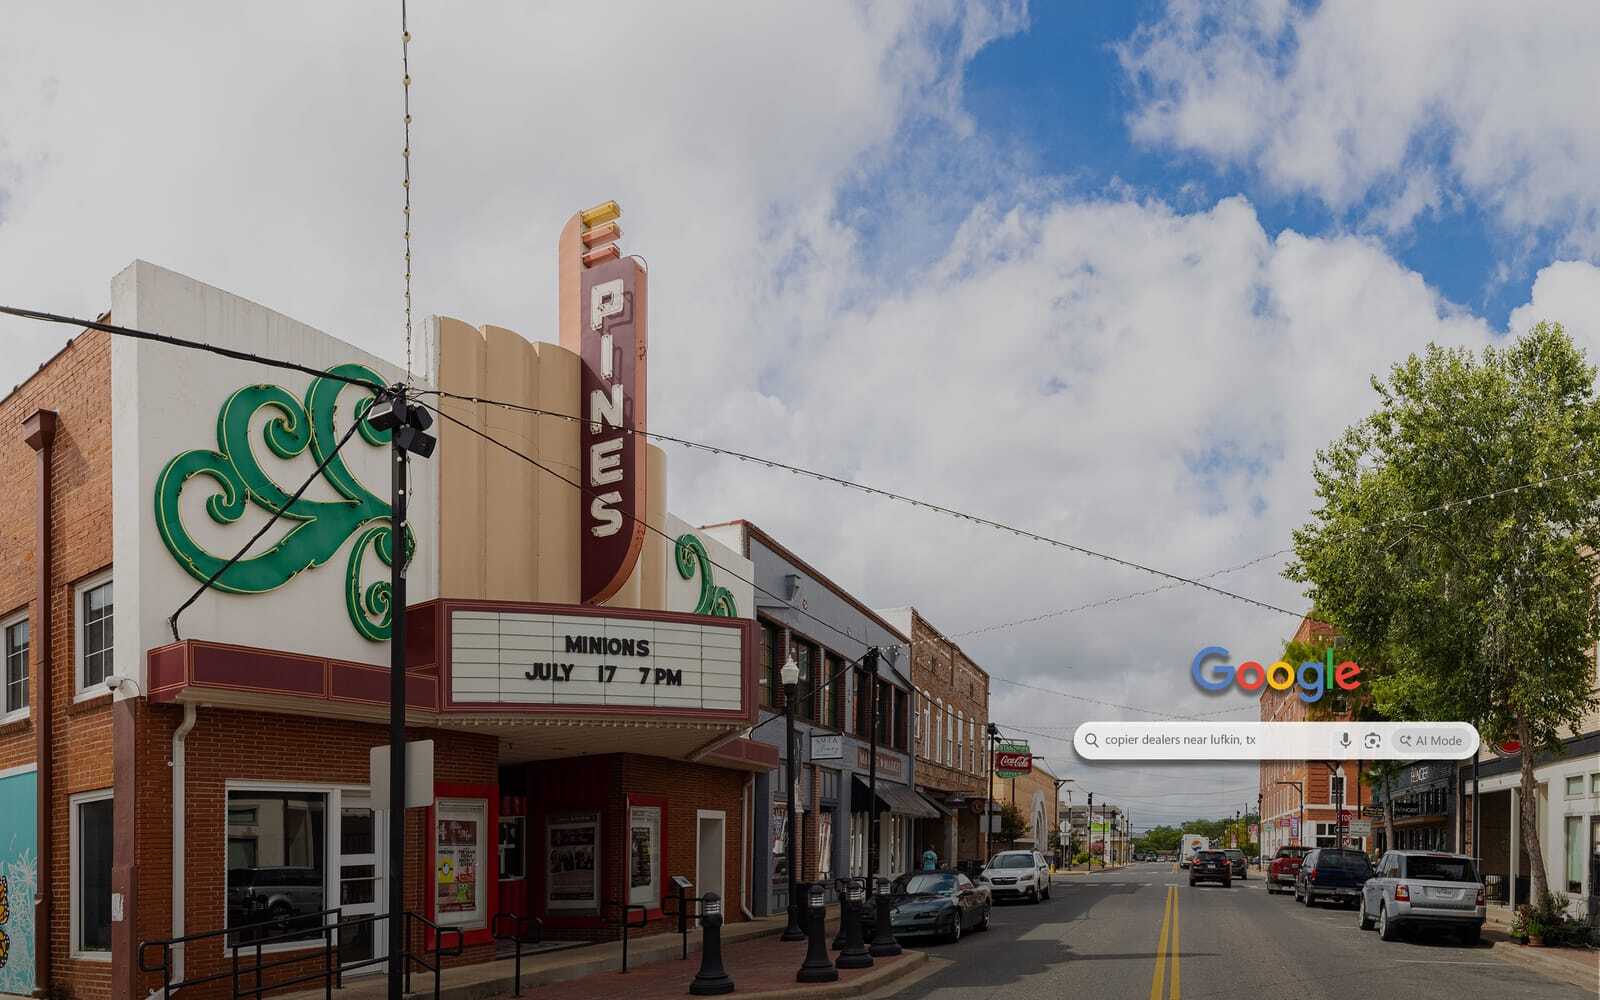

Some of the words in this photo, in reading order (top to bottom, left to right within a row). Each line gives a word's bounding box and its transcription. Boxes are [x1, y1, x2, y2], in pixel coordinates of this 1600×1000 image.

[590, 278, 624, 539] PINES
[565, 635, 651, 657] MINIONS
[525, 663, 575, 682] JULY
[598, 665, 618, 683] 17
